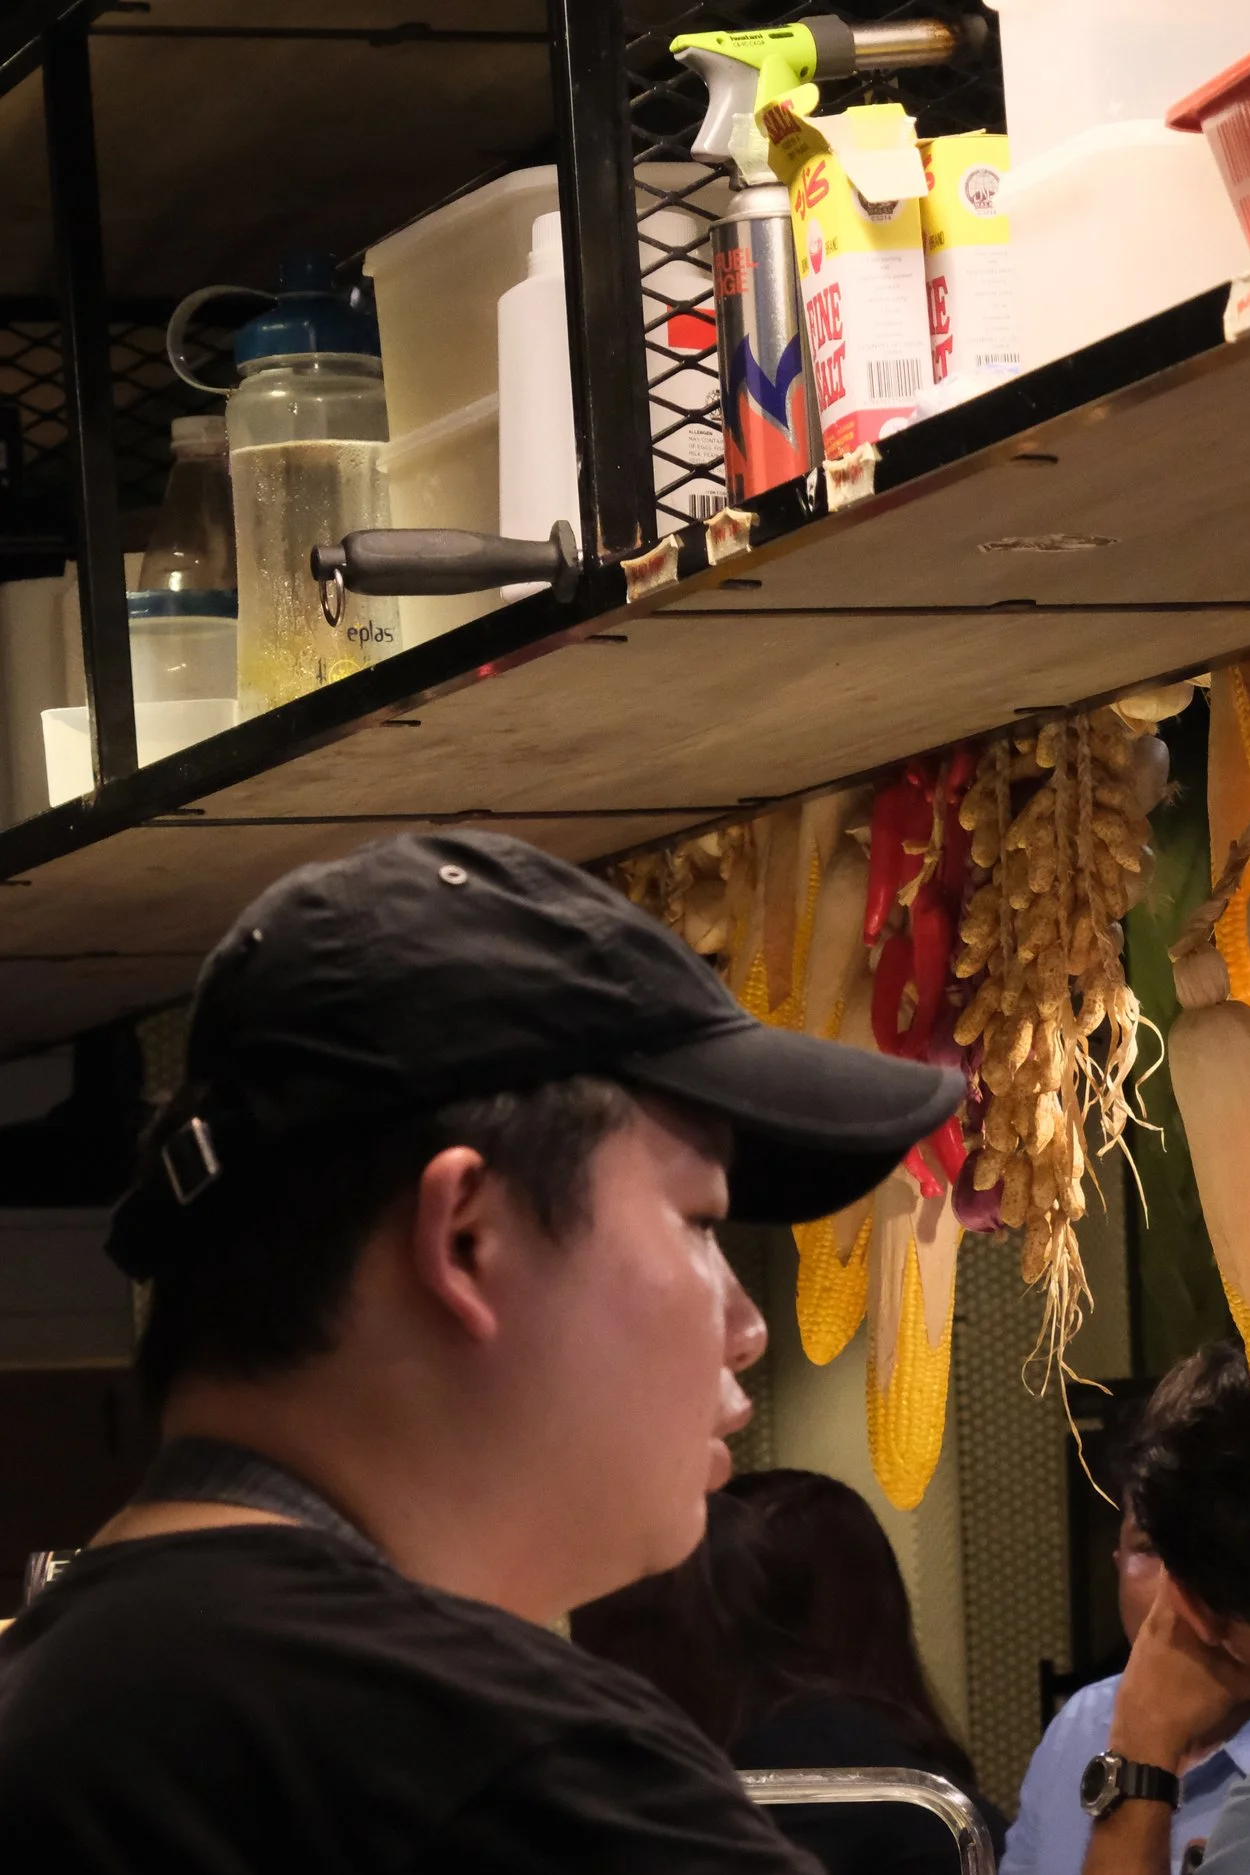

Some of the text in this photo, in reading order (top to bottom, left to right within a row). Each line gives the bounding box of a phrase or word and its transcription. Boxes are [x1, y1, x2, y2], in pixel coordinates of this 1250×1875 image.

[806, 281, 843, 362] FINE
[815, 340, 846, 415] SALT
[347, 619, 394, 649] eplas
